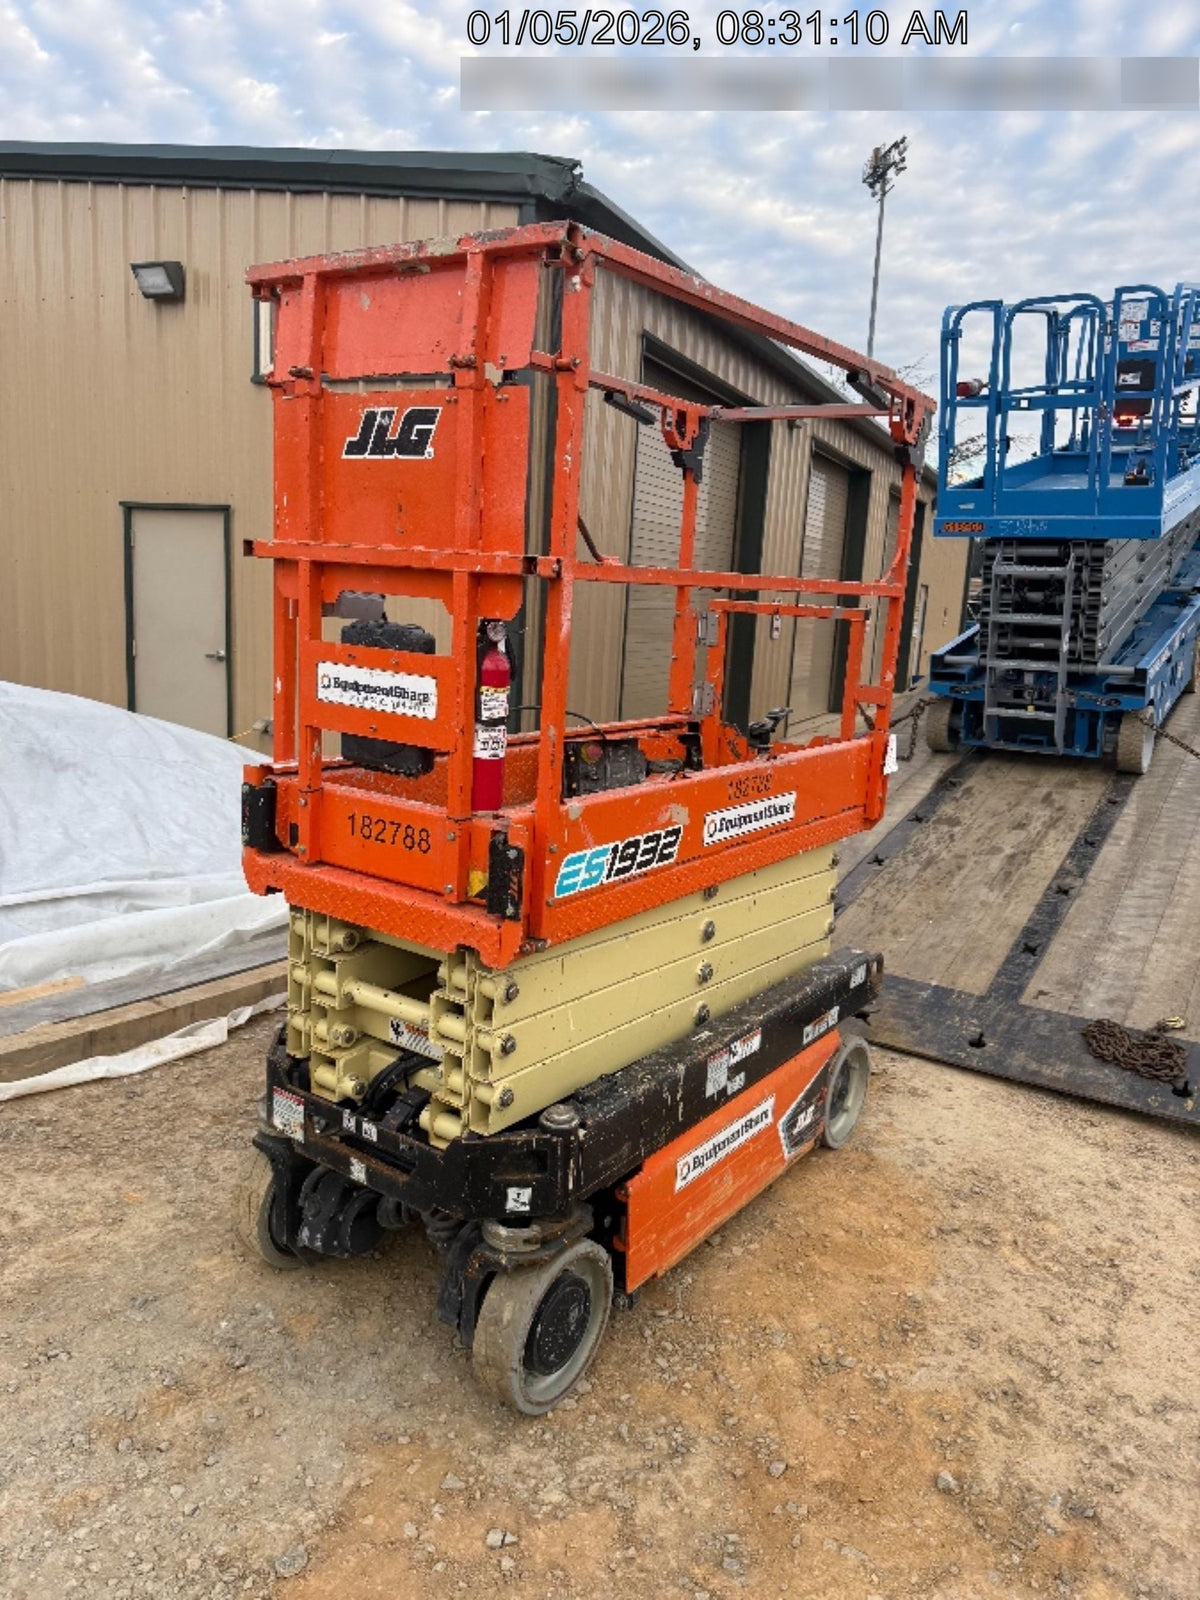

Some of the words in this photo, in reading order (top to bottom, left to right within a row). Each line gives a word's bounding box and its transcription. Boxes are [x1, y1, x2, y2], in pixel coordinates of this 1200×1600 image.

[341, 407, 443, 459] JLG
[348, 812, 431, 854] 182788
[554, 824, 683, 898] ES1932
